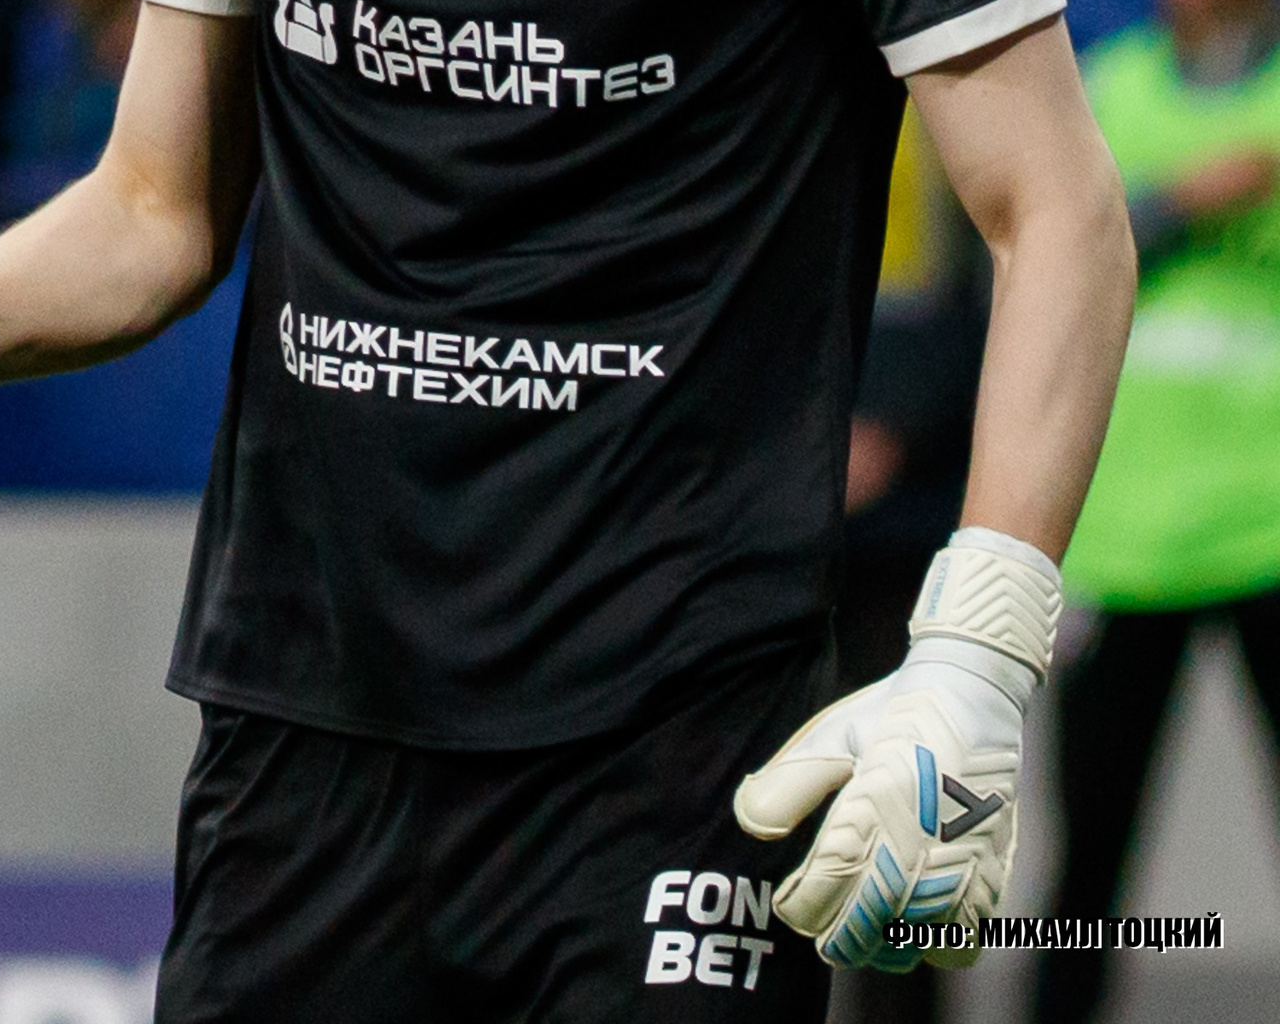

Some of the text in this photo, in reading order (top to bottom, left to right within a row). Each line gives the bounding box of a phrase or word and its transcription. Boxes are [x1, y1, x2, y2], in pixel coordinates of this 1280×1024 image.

[352, 0, 565, 63] КАЗАНЬ
[355, 43, 676, 107] ОРГСИНТЕЗ
[299, 313, 664, 377] НИЖНЕКАМСК
[299, 353, 578, 411] НЕФТЕХИМ
[644, 870, 771, 930] FON
[645, 931, 774, 991] BET
